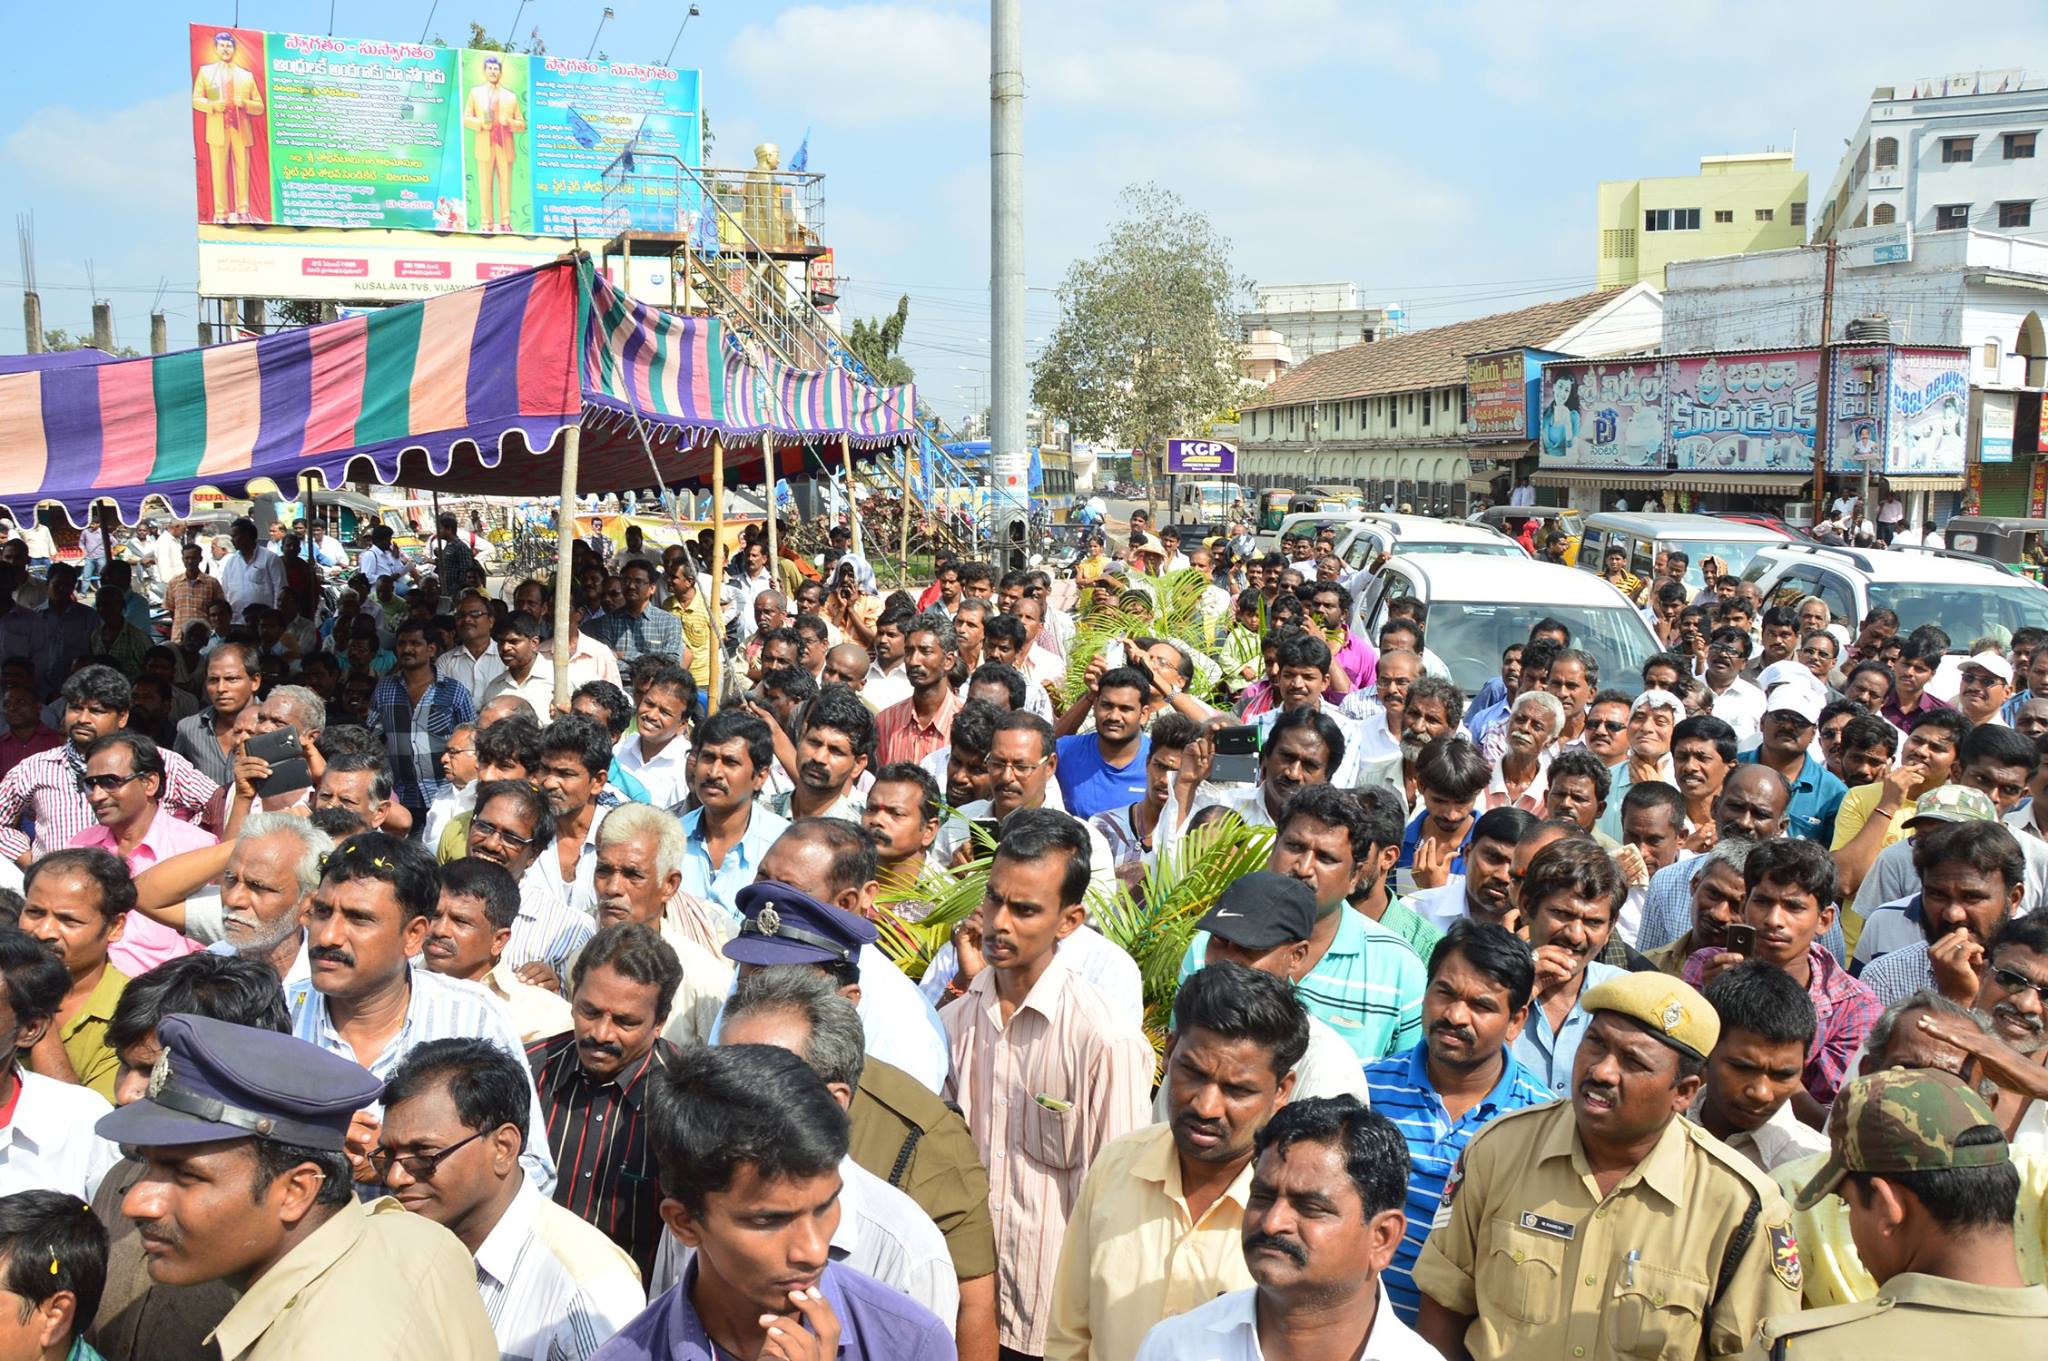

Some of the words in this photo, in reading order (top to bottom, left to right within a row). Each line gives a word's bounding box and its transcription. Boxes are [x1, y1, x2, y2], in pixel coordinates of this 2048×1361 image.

[286, 35, 345, 54] స్వాగతం
[360, 41, 435, 61] సుస్వాగతం
[385, 68, 404, 80] మా
[545, 58, 599, 75] స్వాగతం
[611, 63, 678, 81] సుస్వాగతం
[354, 282, 408, 291] KUSALAVA
[1697, 358, 1723, 405] శ్రీ
[1724, 361, 1798, 393] లలితా
[1894, 383, 1924, 417] COOL
[1924, 370, 1968, 407] DRINKS
[1180, 442, 1222, 456] KCP
